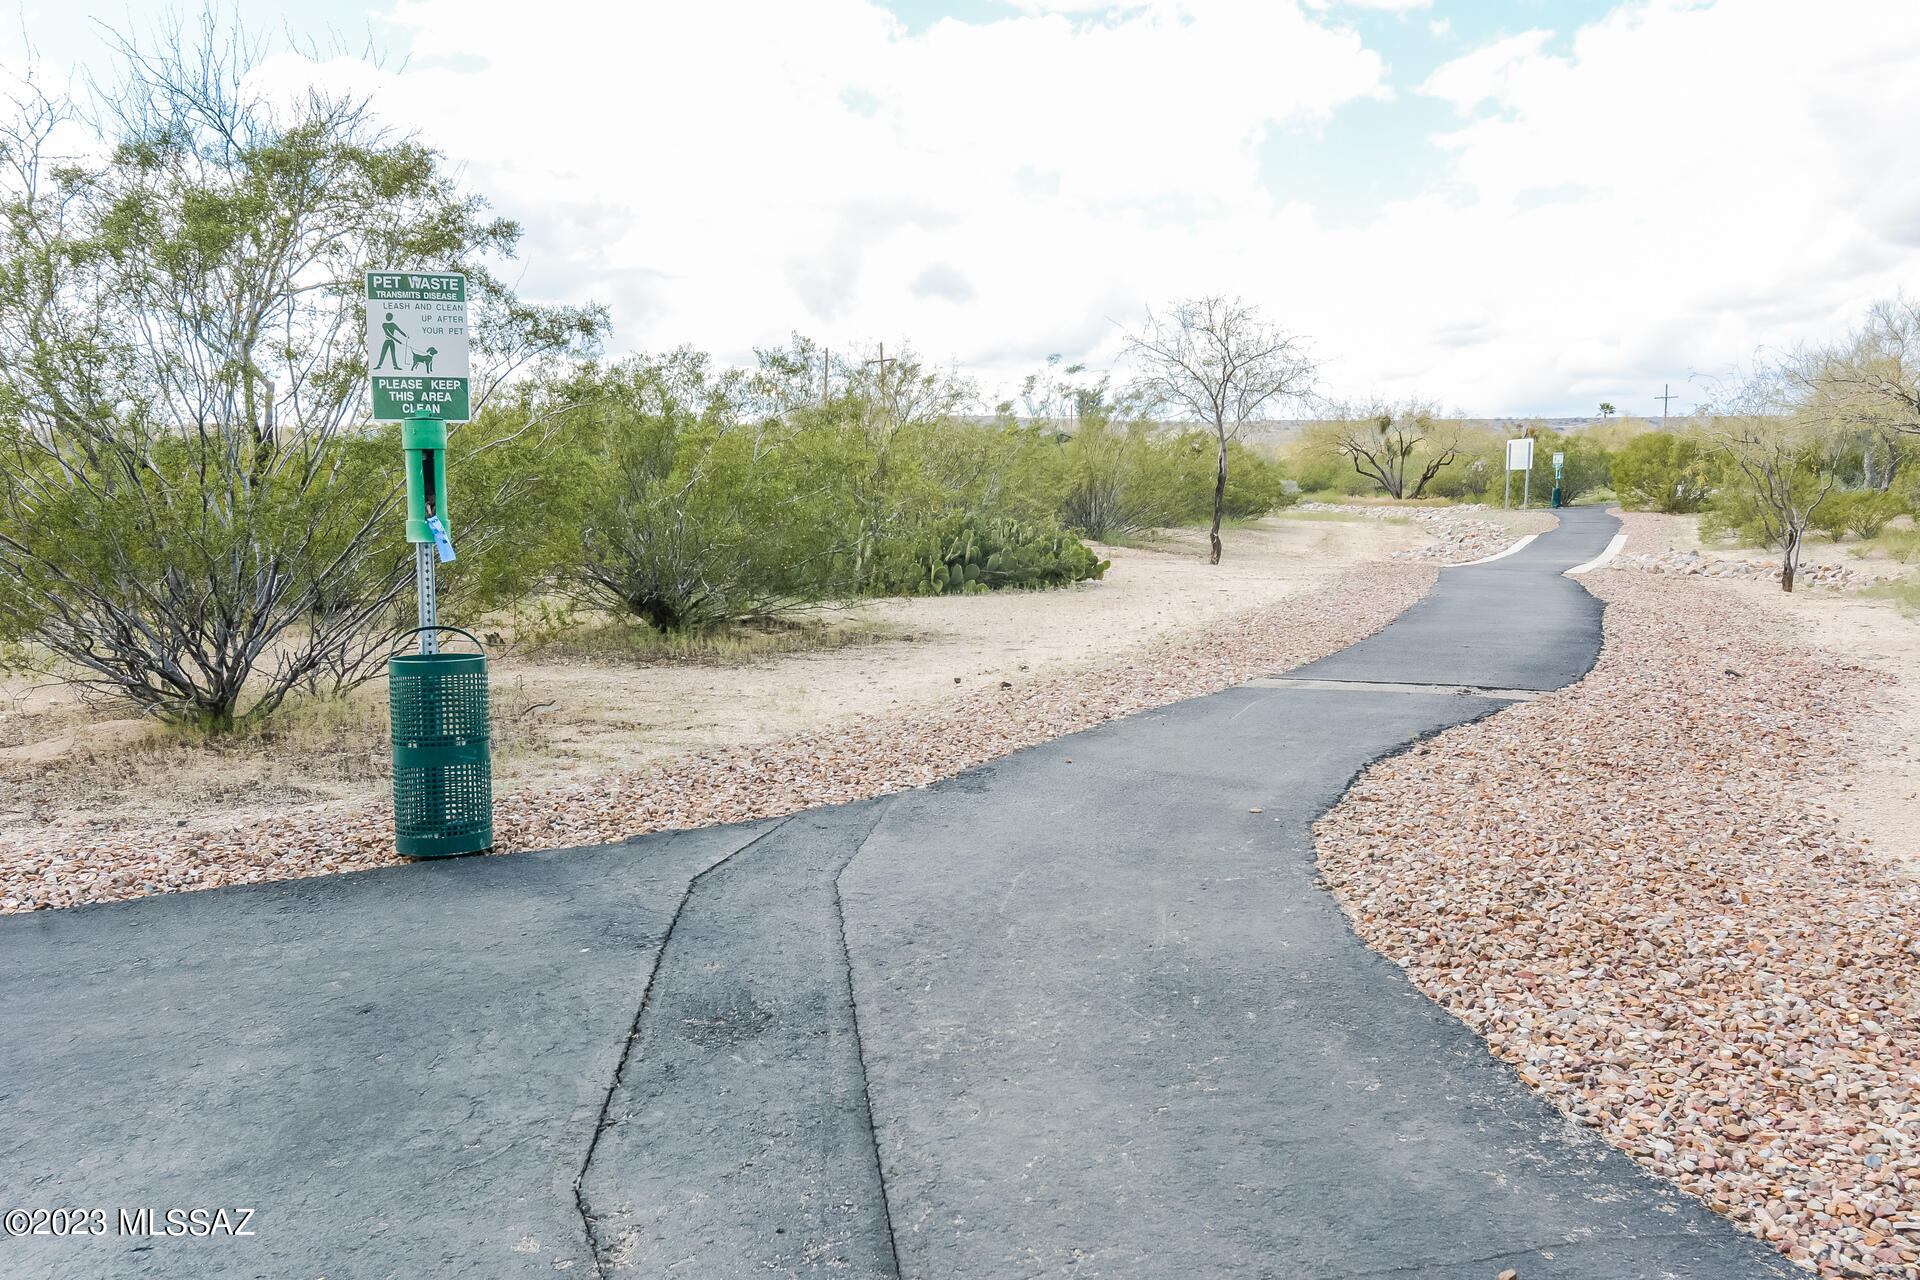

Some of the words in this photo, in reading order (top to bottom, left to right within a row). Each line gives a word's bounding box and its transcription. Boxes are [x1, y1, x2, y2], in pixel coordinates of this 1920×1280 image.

[373, 275, 401, 289] PET
[408, 275, 459, 291] WASTE
[376, 290, 421, 299] TRANSMITS
[423, 292, 457, 300] DISEASE
[383, 302, 410, 310] LEASH
[415, 303, 432, 311] AND
[436, 303, 463, 312] CLEAN
[437, 315, 464, 324] AFTER
[422, 327, 444, 335] YOUR
[378, 379, 423, 390] PLEASE
[431, 380, 461, 390] KEEP
[389, 391, 414, 402] THIS
[421, 392, 452, 402] AREA
